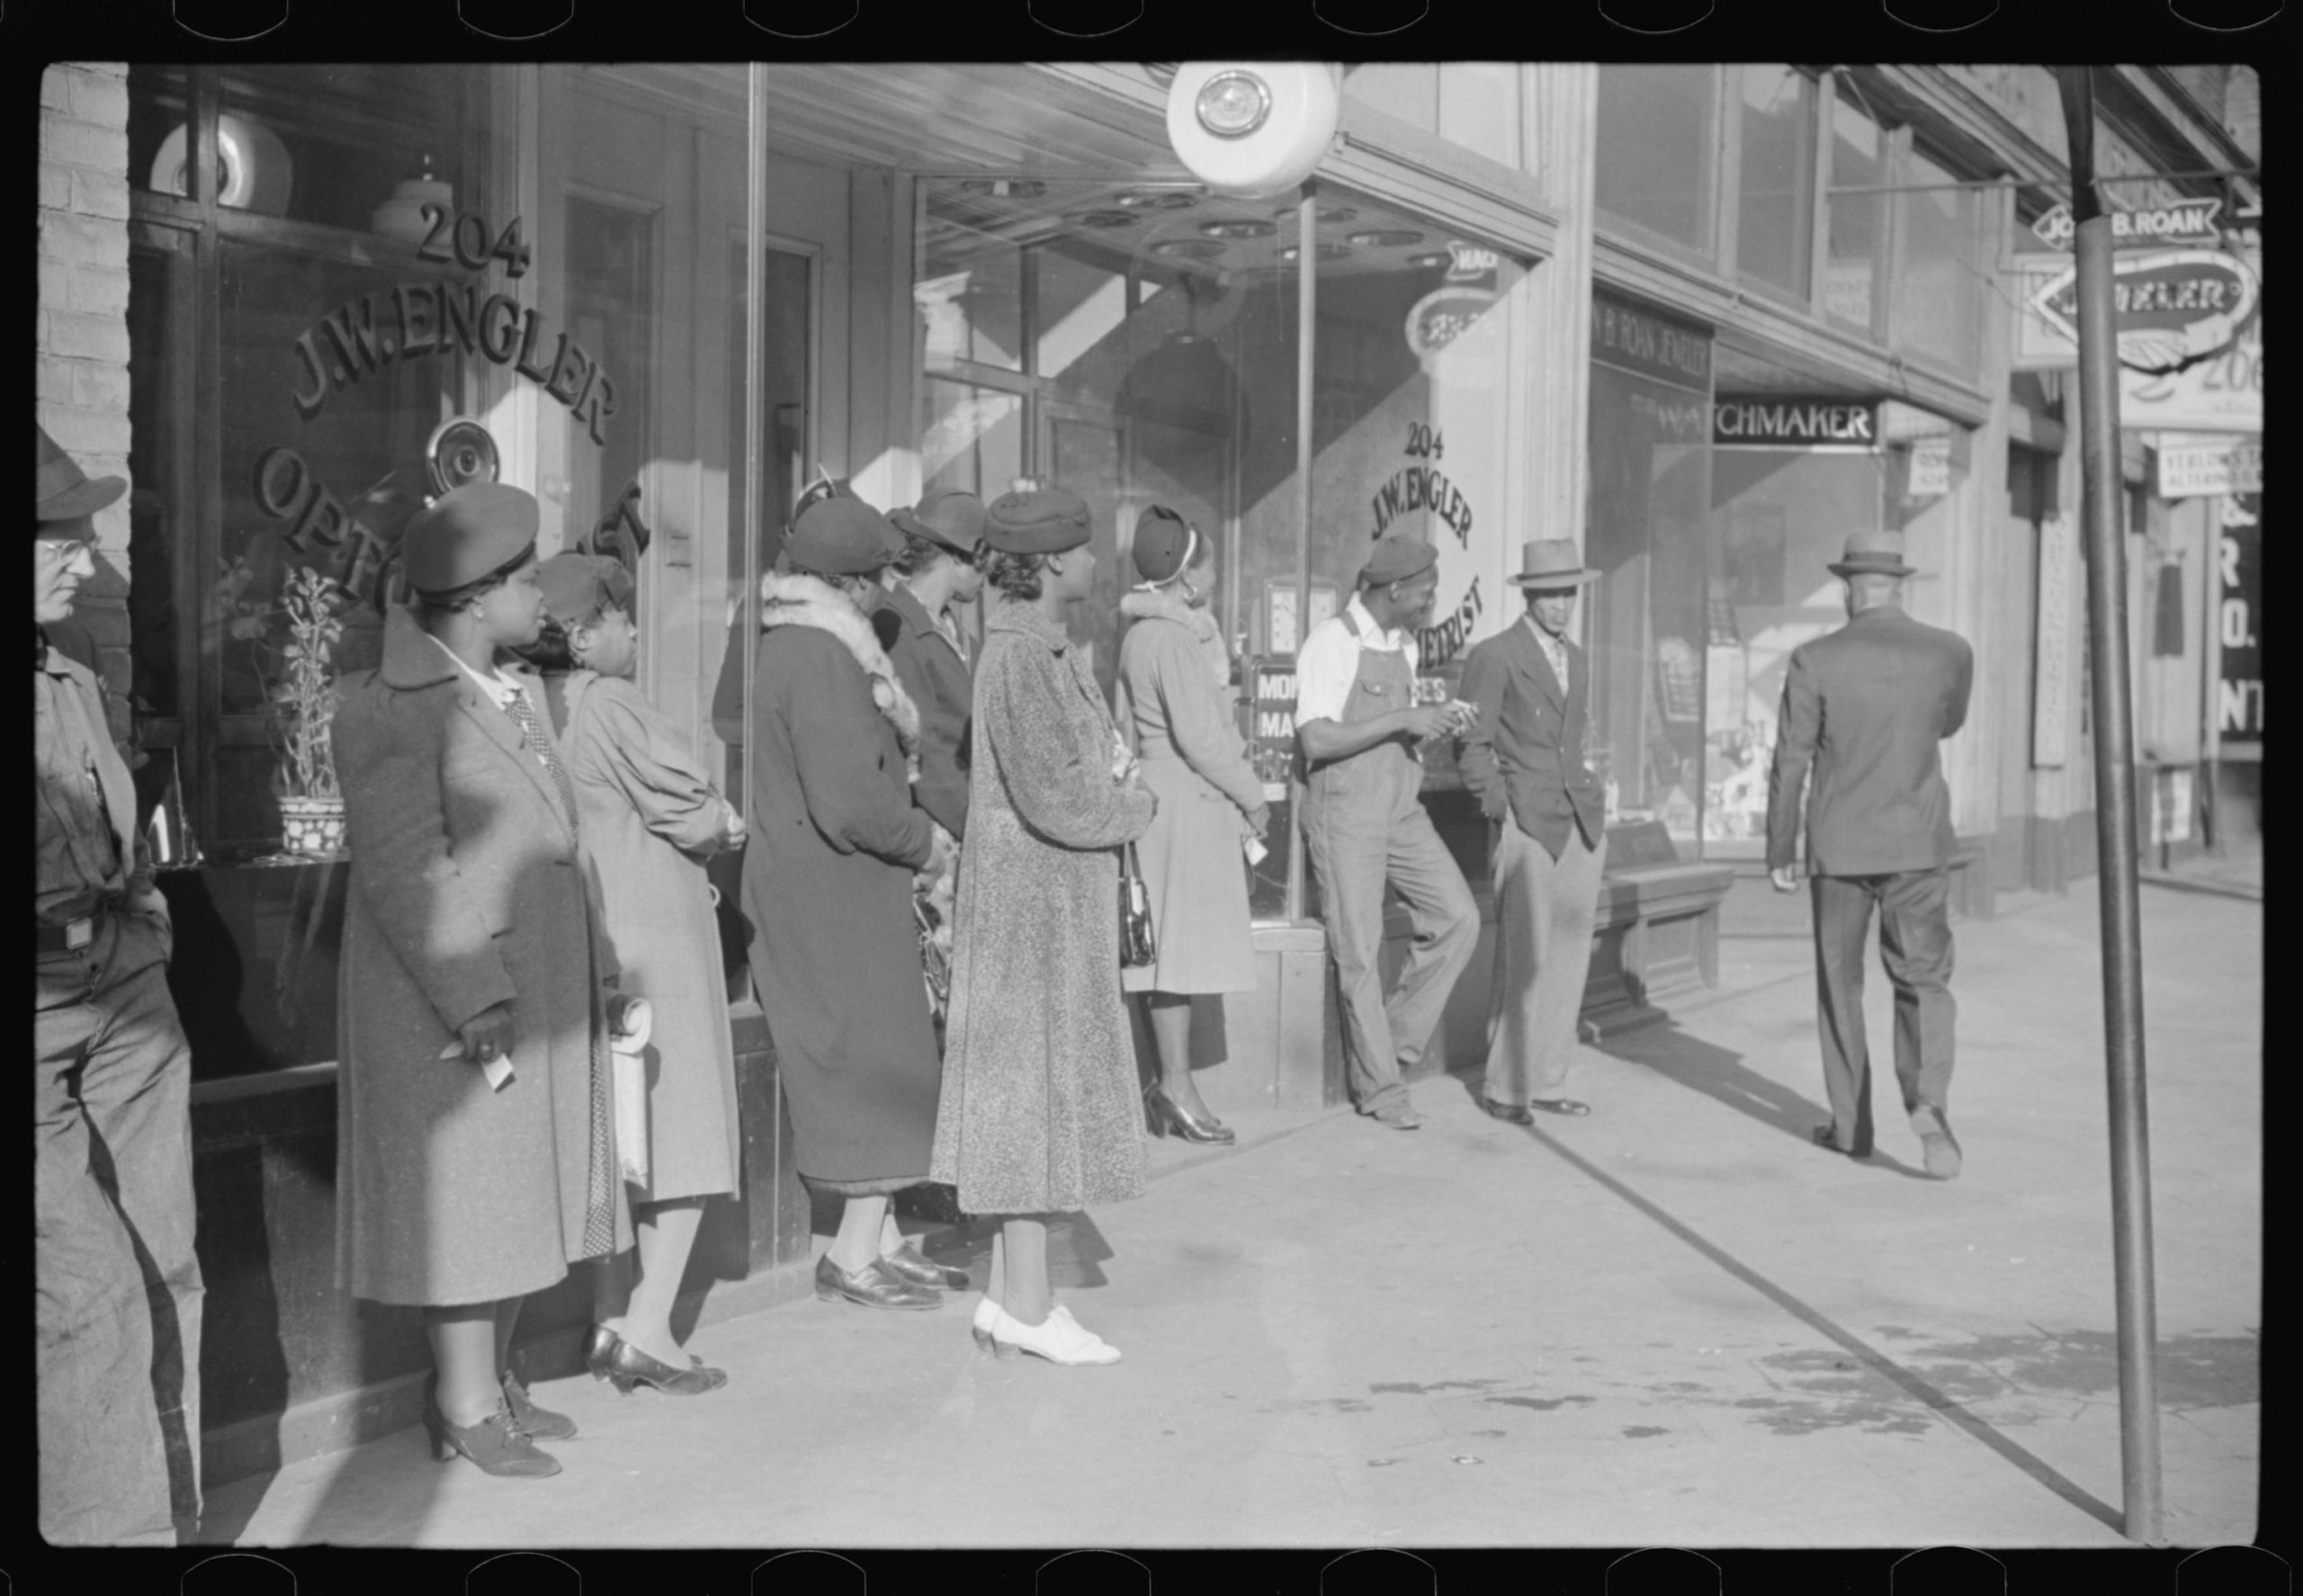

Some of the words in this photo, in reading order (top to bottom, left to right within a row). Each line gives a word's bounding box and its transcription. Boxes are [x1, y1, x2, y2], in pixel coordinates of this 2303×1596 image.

[417, 201, 531, 279] 204
[1404, 420, 1445, 461] 204
[1658, 402, 1873, 439] WACHMAKER
